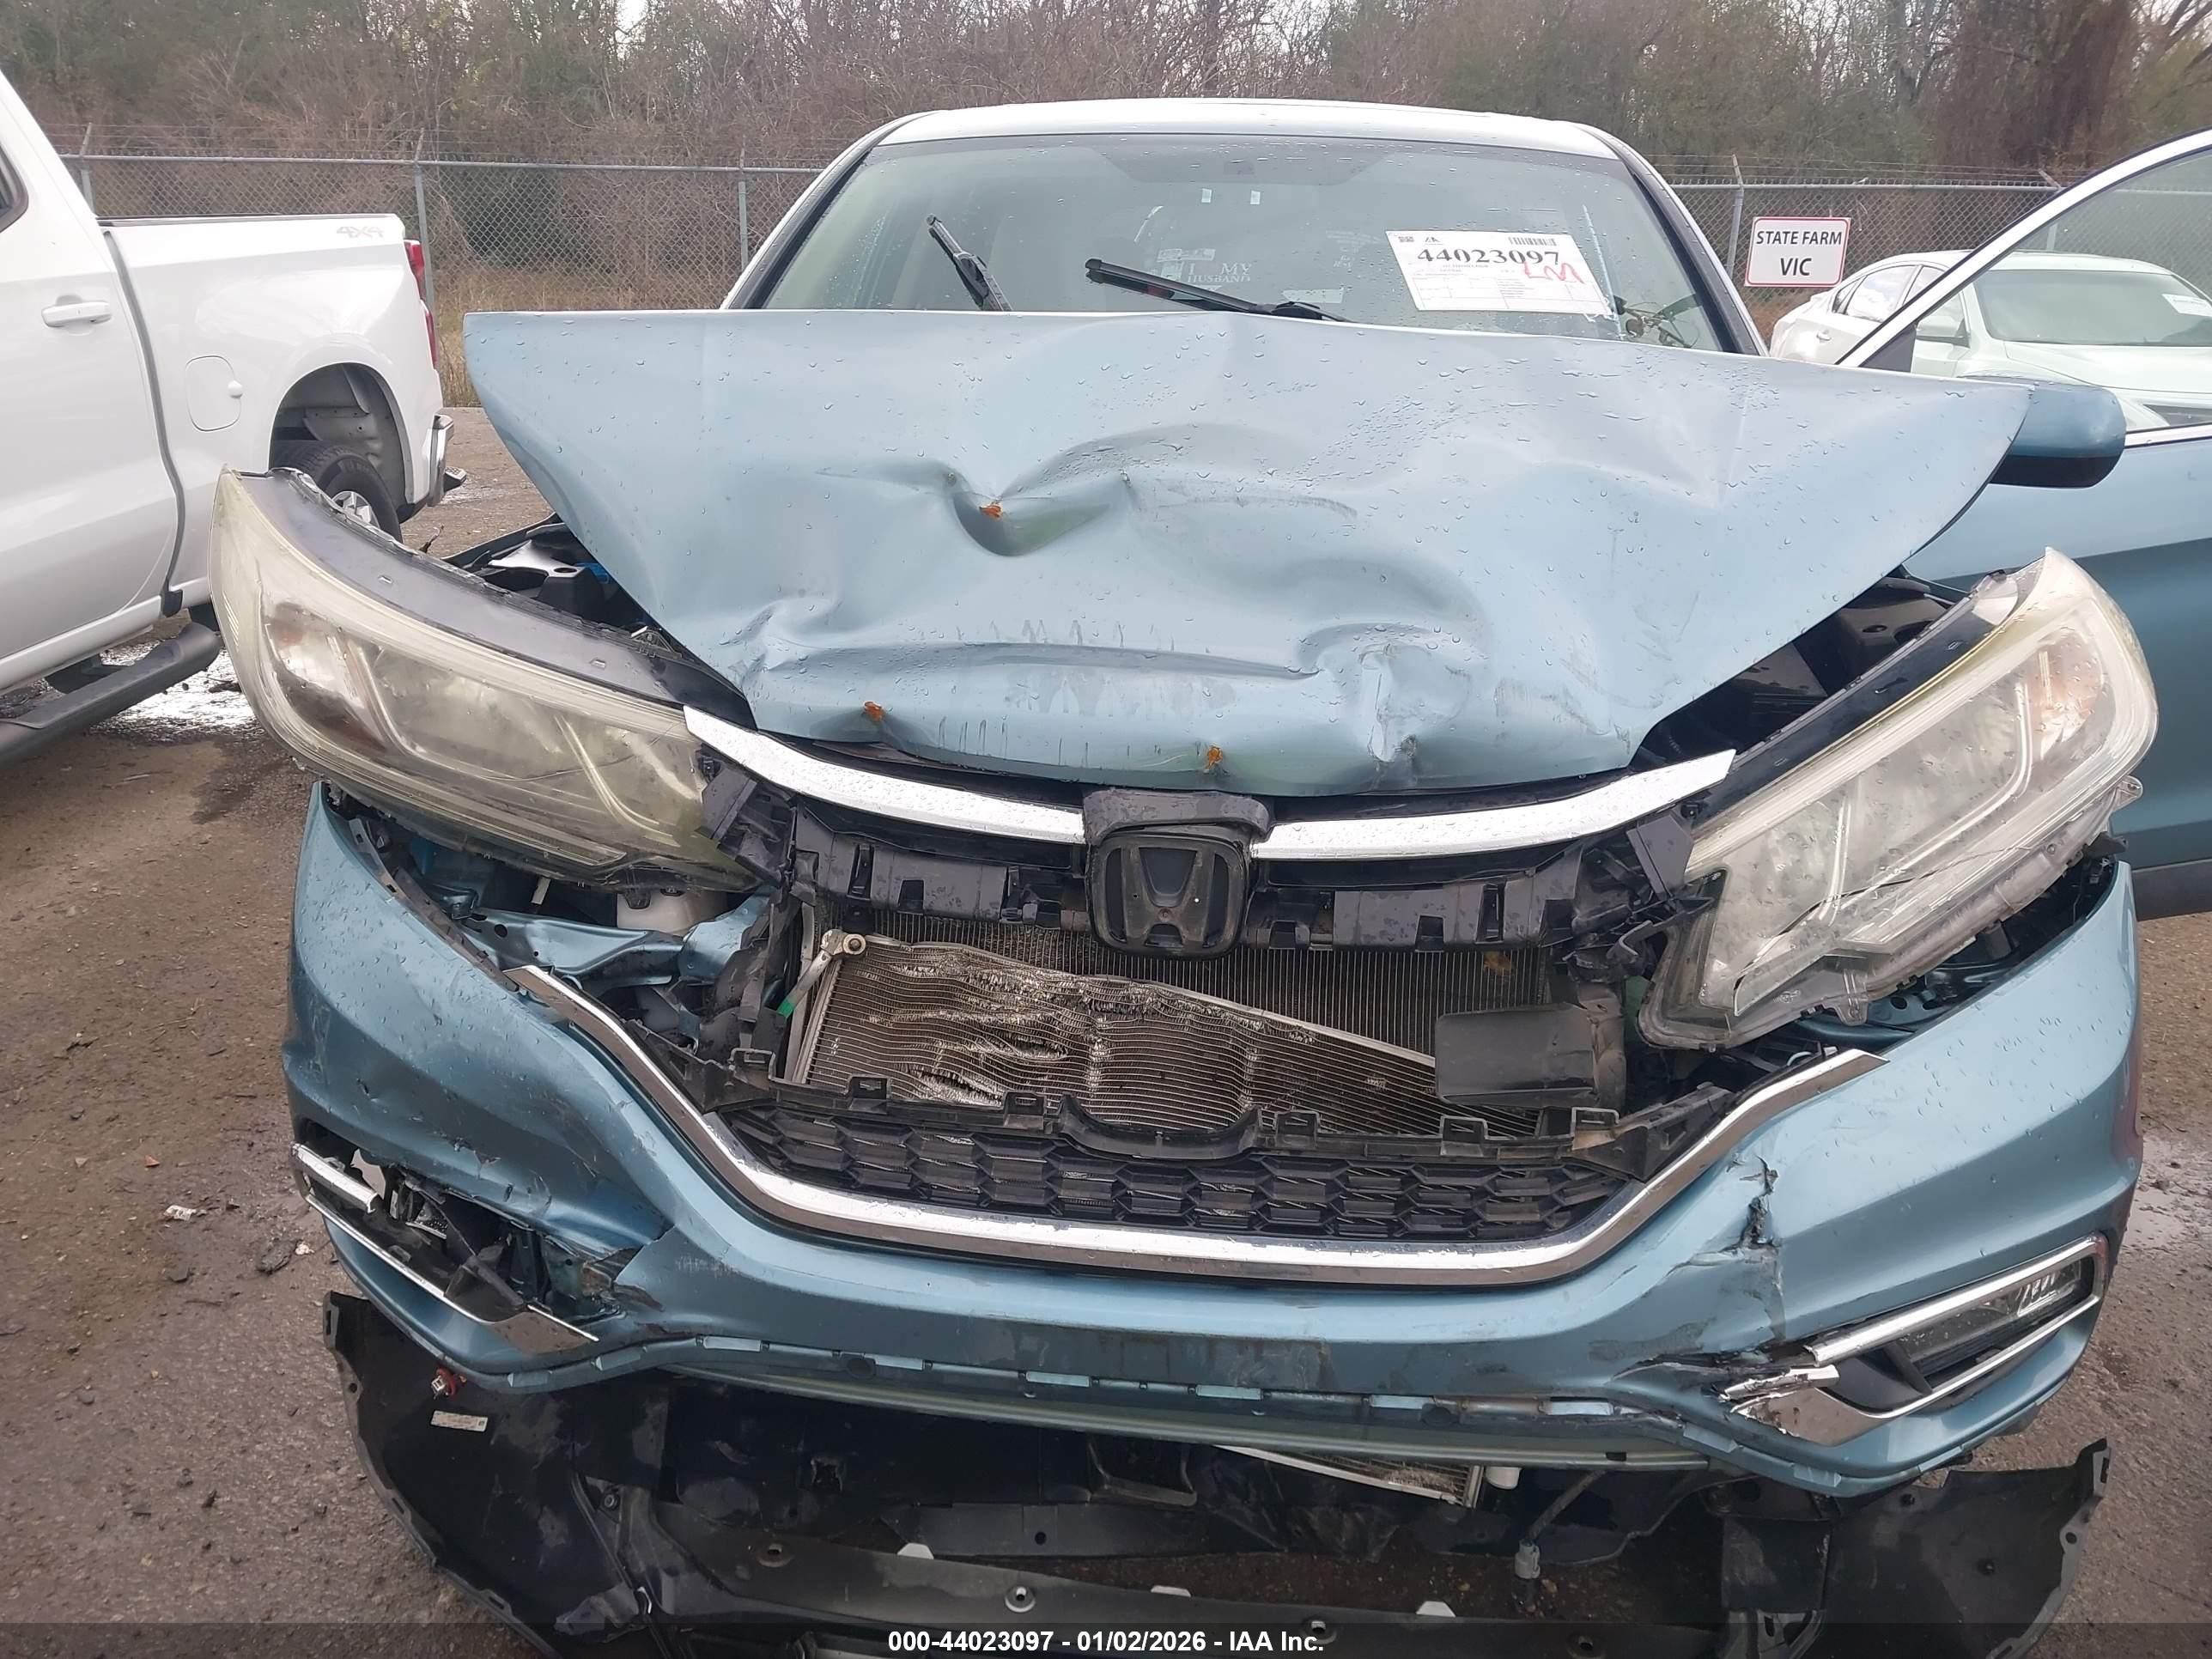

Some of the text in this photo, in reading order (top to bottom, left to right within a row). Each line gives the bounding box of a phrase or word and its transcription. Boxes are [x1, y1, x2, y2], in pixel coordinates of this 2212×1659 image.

[1756, 231, 1843, 245] STATE FARM
[1418, 248, 1559, 264] 44023097
[1780, 258, 1812, 276] VIC
